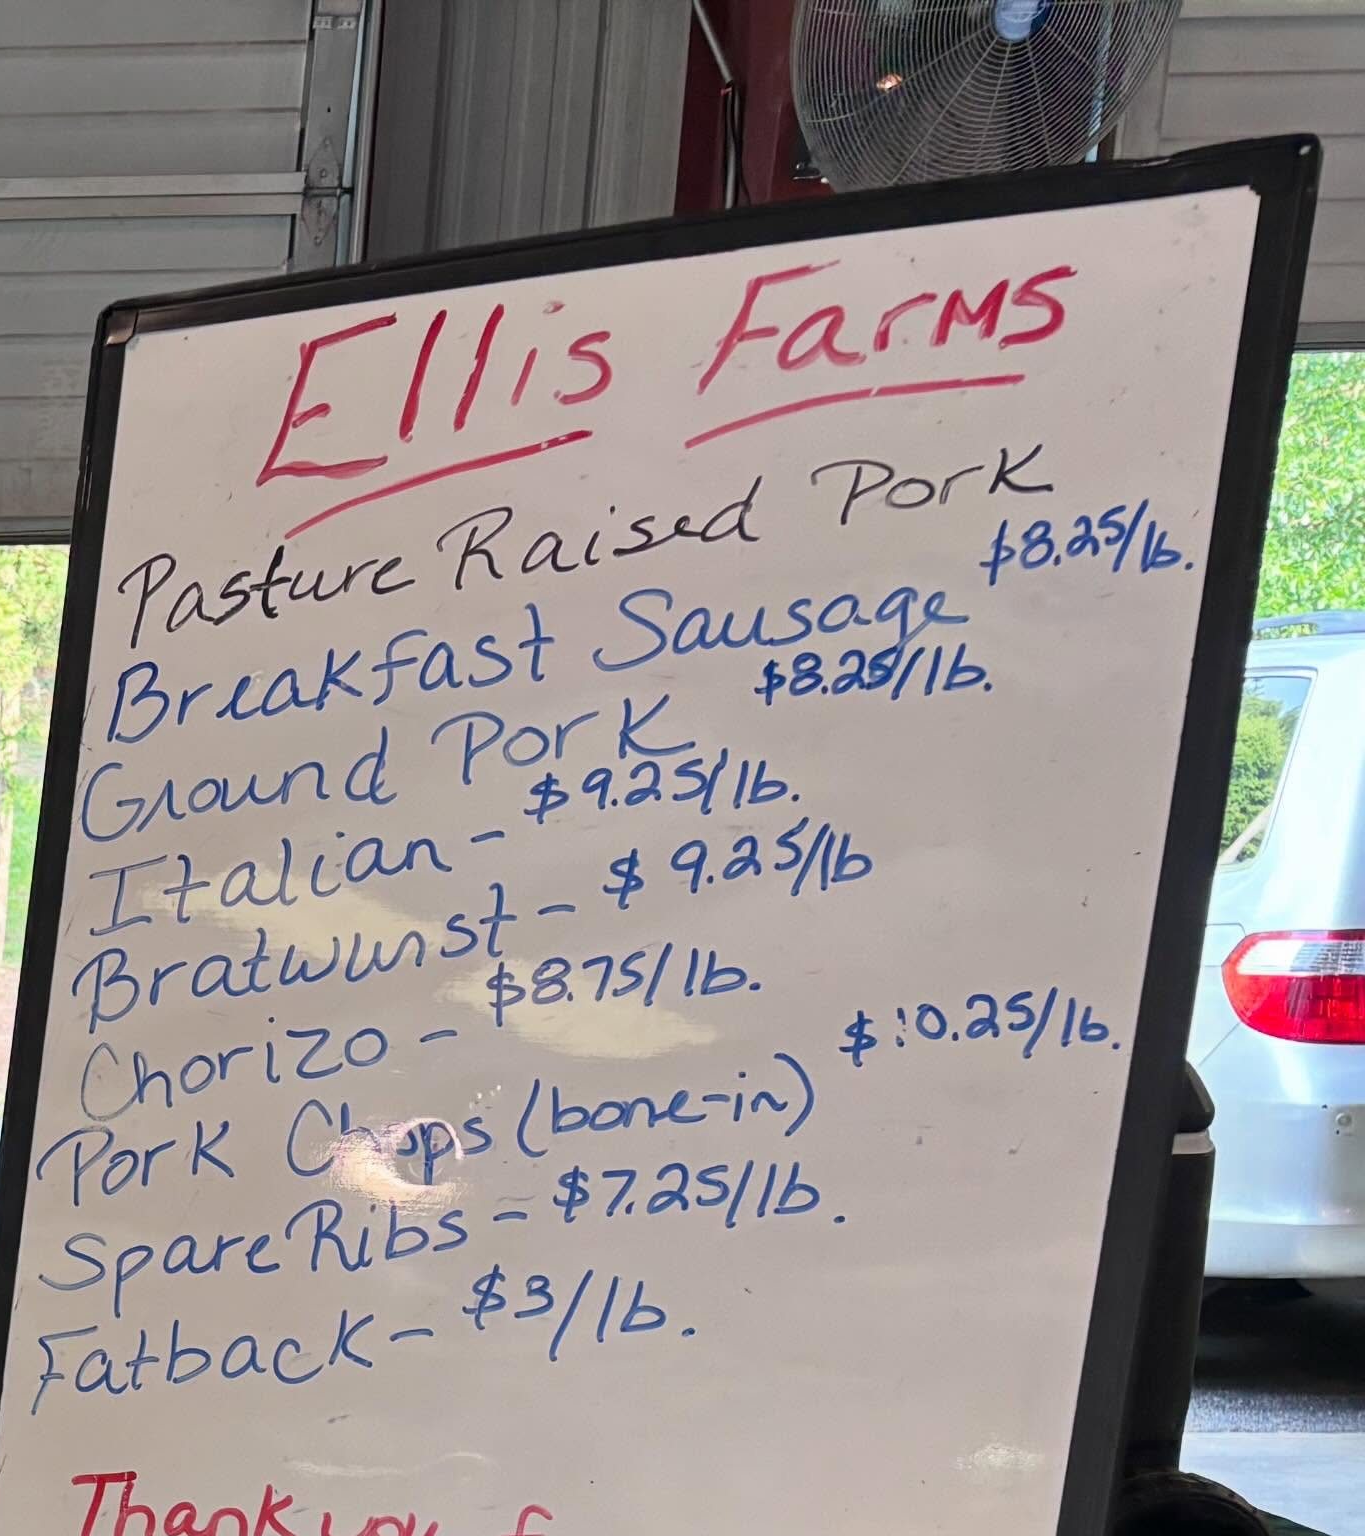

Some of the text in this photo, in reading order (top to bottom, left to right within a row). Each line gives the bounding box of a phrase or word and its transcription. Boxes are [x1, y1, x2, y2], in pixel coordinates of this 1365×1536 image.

[255, 259, 1077, 487] Ellis Farms
[117, 444, 1054, 649] Pasture Raised Pork
[107, 602, 556, 743] Breakfast
[593, 586, 970, 672] Sausage
[81, 726, 398, 842] Ground
[431, 695, 696, 785] Pork
[36, 1120, 234, 1207] Pork
[517, 1053, 815, 1158] (bone-in)
[31, 1309, 374, 1416] Fatback
